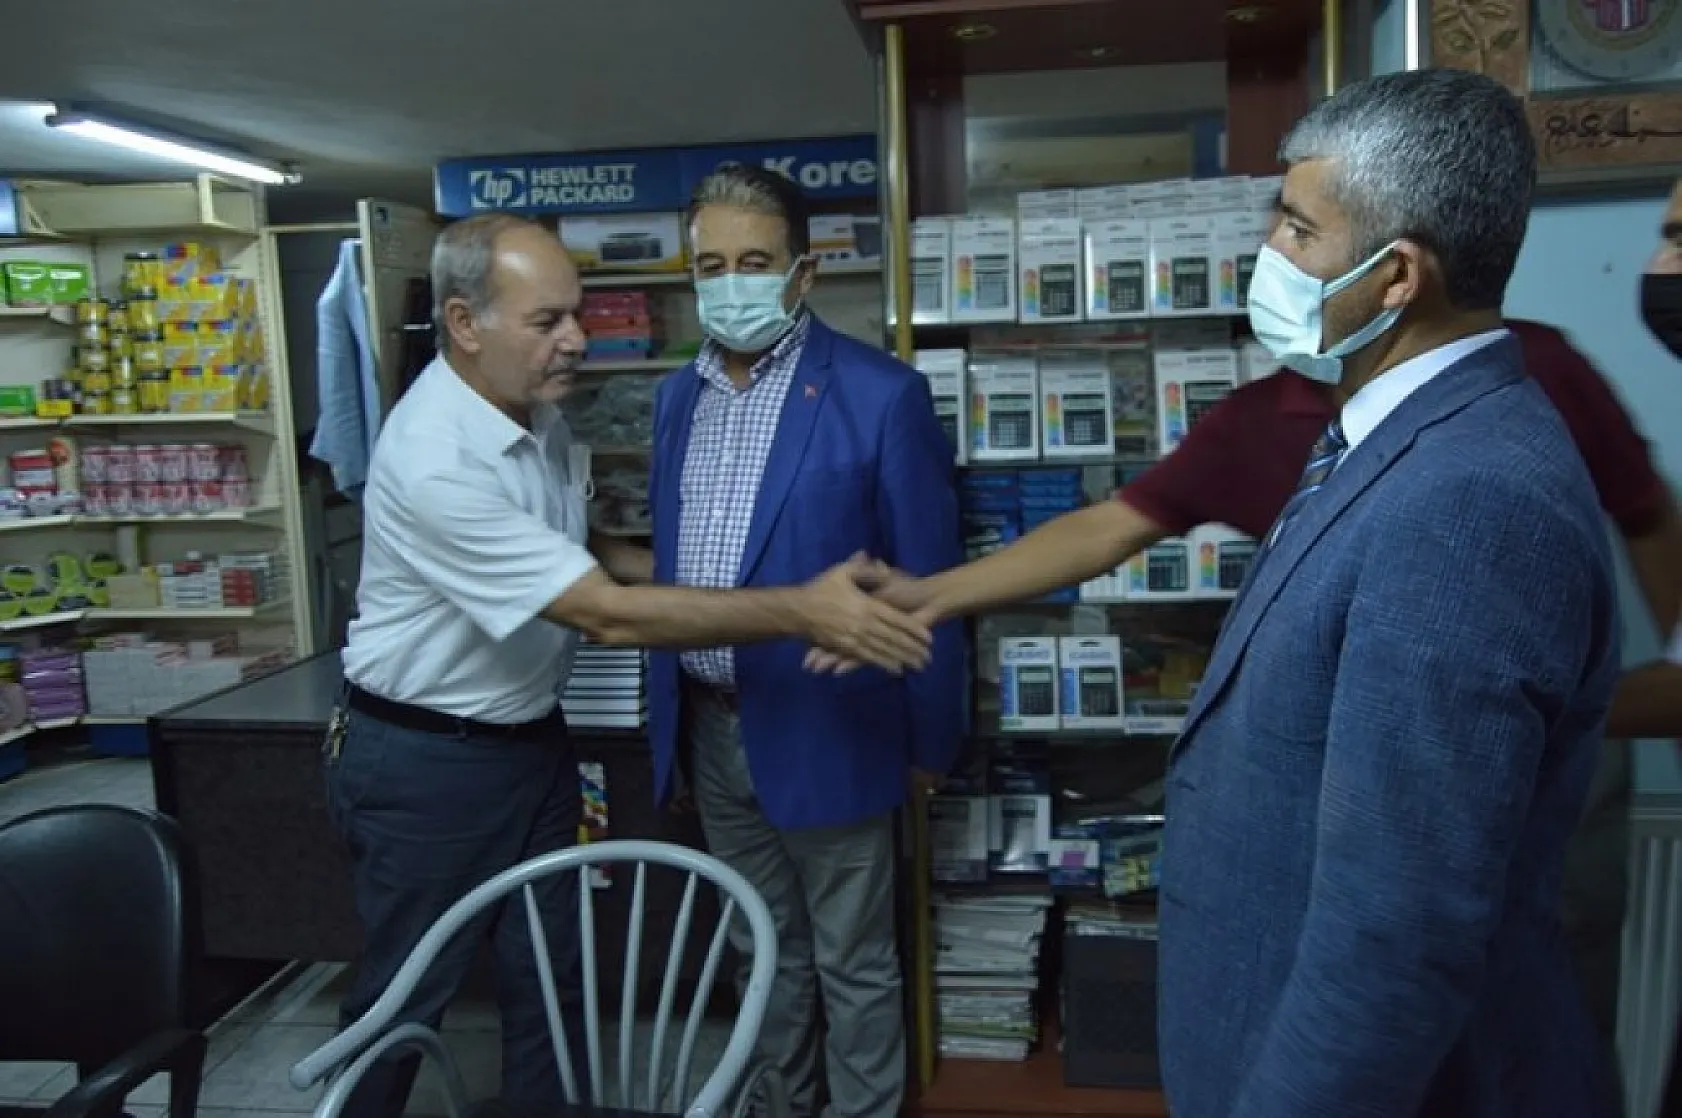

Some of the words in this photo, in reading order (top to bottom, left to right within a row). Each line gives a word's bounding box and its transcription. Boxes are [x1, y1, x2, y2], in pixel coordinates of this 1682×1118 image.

[531, 164, 636, 185] HEWLETT
[484, 172, 513, 208] hp
[531, 185, 634, 205] PACKARD
